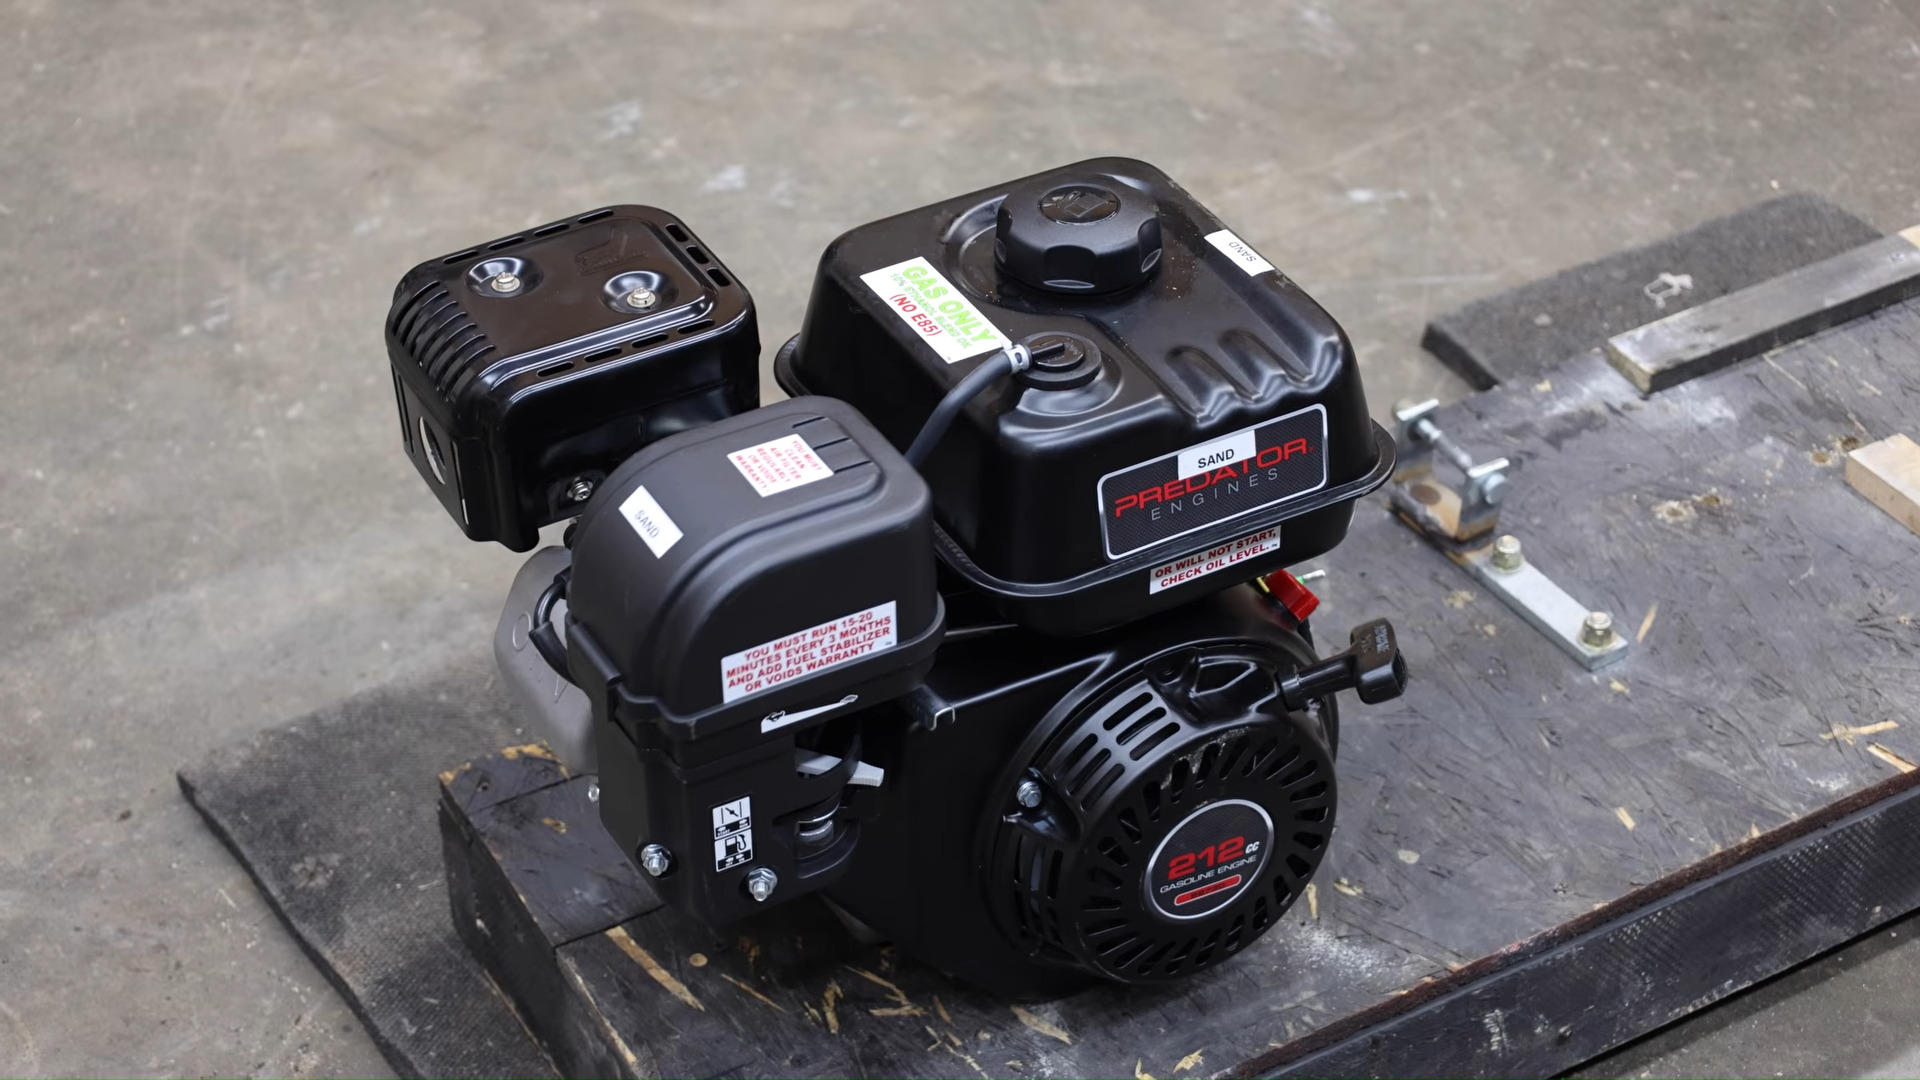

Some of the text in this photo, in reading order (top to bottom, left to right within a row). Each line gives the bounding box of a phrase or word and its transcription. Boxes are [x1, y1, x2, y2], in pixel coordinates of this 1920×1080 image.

[1229, 242, 1256, 262] SAND
[889, 293, 943, 336] (NO E85)
[903, 266, 997, 342] GAS ONLY
[770, 447, 802, 479] AIR FILTER
[784, 448, 805, 469] CLEAN
[1197, 449, 1235, 468] SAND
[1151, 468, 1278, 521] ENGINES
[635, 509, 660, 538] SAND
[1155, 529, 1276, 578] OR WILL NOT START,
[1161, 544, 1269, 587] CHECK OIL LEVEL.
[726, 616, 891, 678] MINUTES EVERY 3 MONTHS
[728, 626, 890, 688] AND ADD FUEL STABILIZER
[745, 611, 872, 661] YOU MUST RUN 15-20
[745, 642, 875, 692] OR VOIDS WARRANTY
[1160, 869, 1215, 893] GASOLINE
[1217, 854, 1257, 875] ENGINE
[1168, 835, 1245, 880] 212
